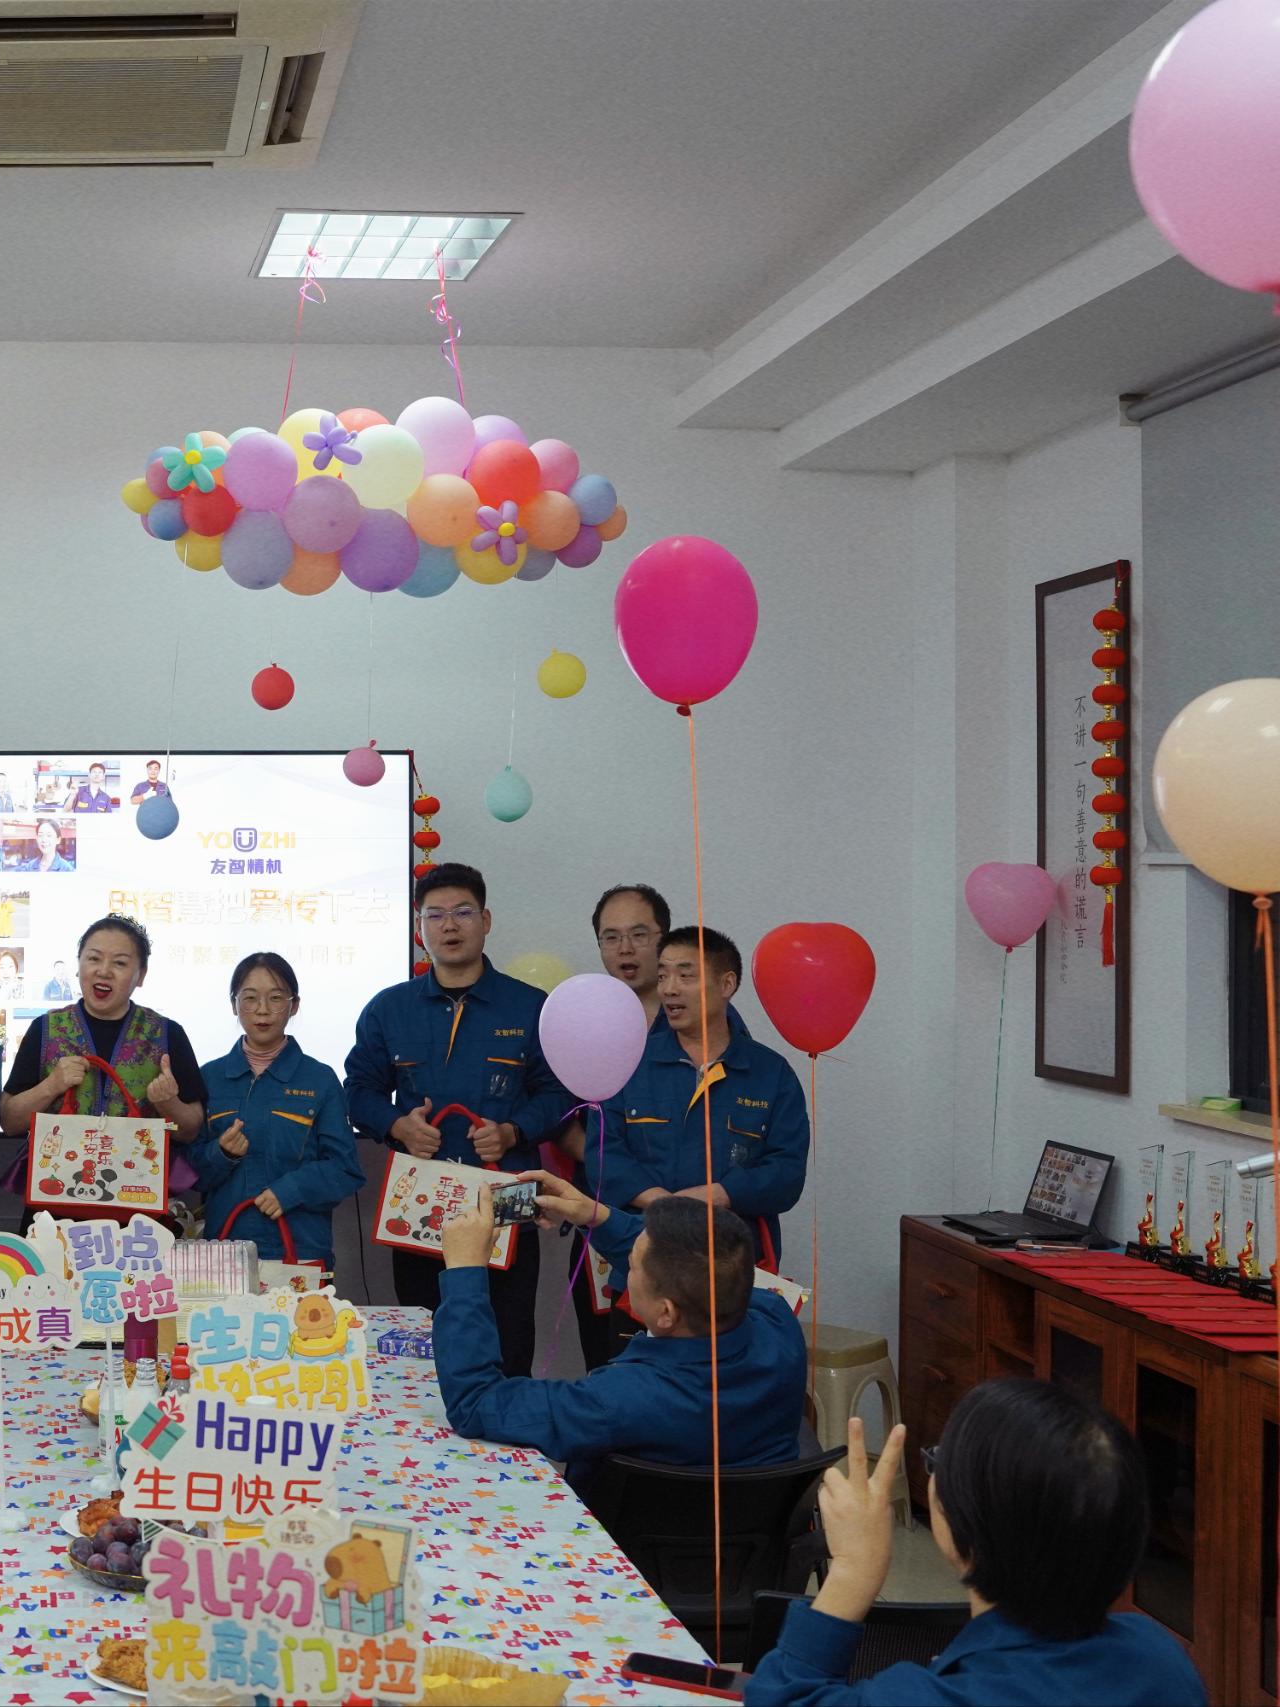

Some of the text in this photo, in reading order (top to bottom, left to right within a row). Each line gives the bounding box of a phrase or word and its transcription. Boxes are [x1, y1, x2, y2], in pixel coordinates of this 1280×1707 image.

[197, 828, 296, 852] YOUZHI
[1073, 695, 1088, 949] 不讲一句善意的谎言
[210, 859, 283, 875] 友智精机
[70, 1219, 163, 1273] 到点
[81, 1272, 180, 1325] 愿啦
[190, 1309, 289, 1366] 生日
[196, 1400, 335, 1471] Happy
[134, 1467, 324, 1516] 生日快乐
[149, 1540, 316, 1627] 礼物
[150, 1620, 418, 1694] 来敲门啦
